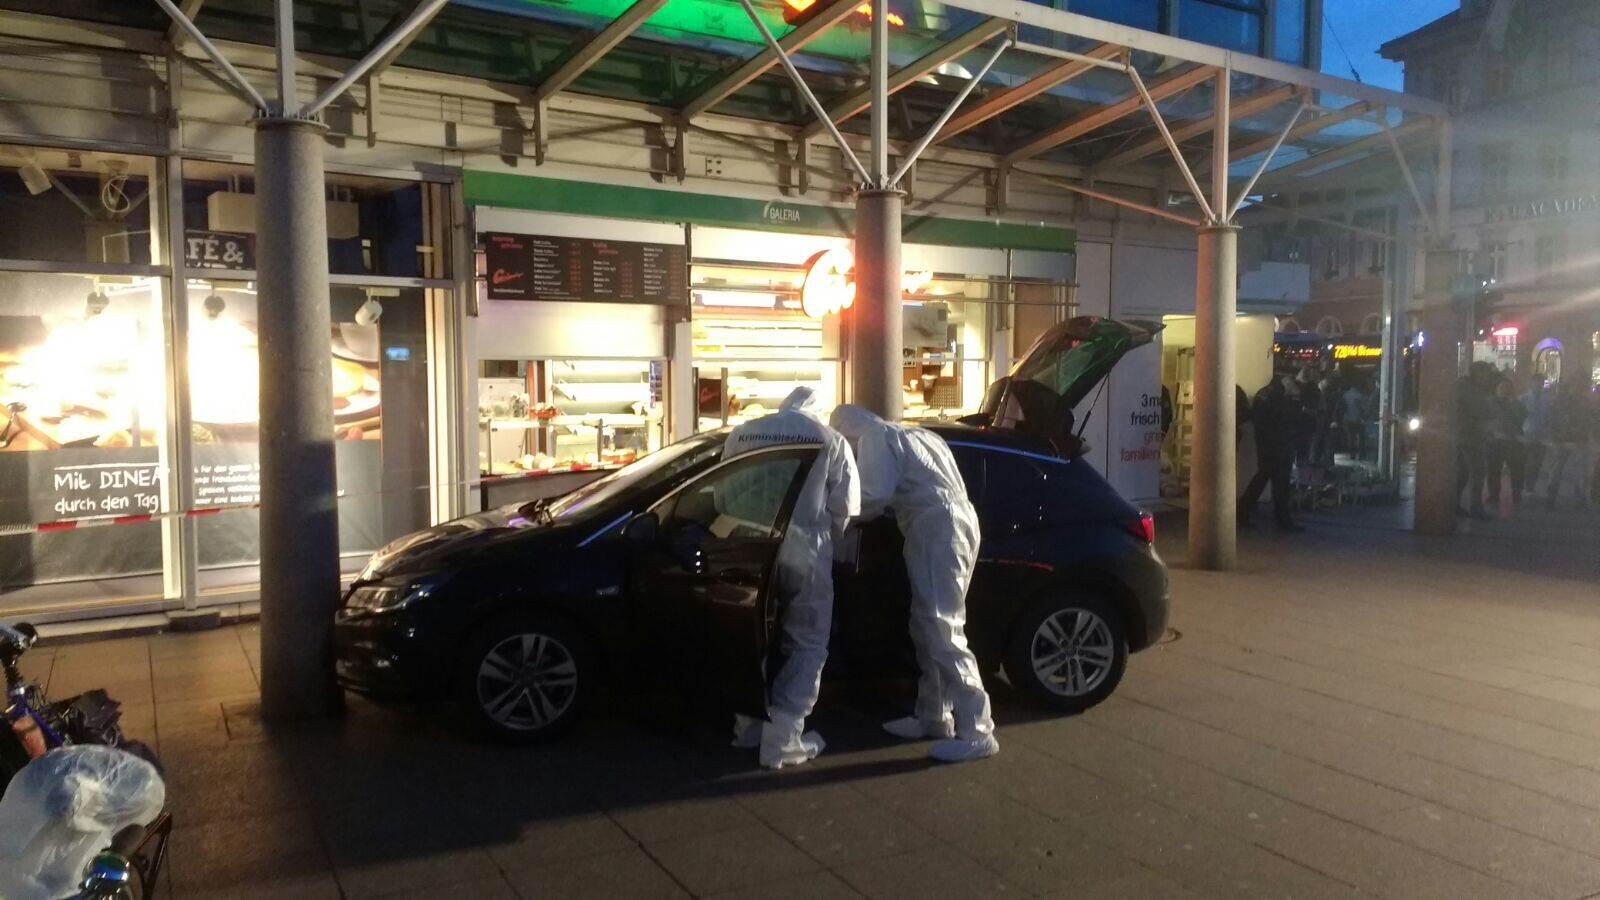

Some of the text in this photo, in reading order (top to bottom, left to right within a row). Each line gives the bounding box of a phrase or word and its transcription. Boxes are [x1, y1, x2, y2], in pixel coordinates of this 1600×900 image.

[769, 206, 801, 222] GALERIA
[222, 240, 244, 263] &
[1141, 393, 1148, 407] 3
[1131, 411, 1160, 425] frisch
[54, 471, 91, 491] Mit
[54, 492, 159, 515] durch den Tag
